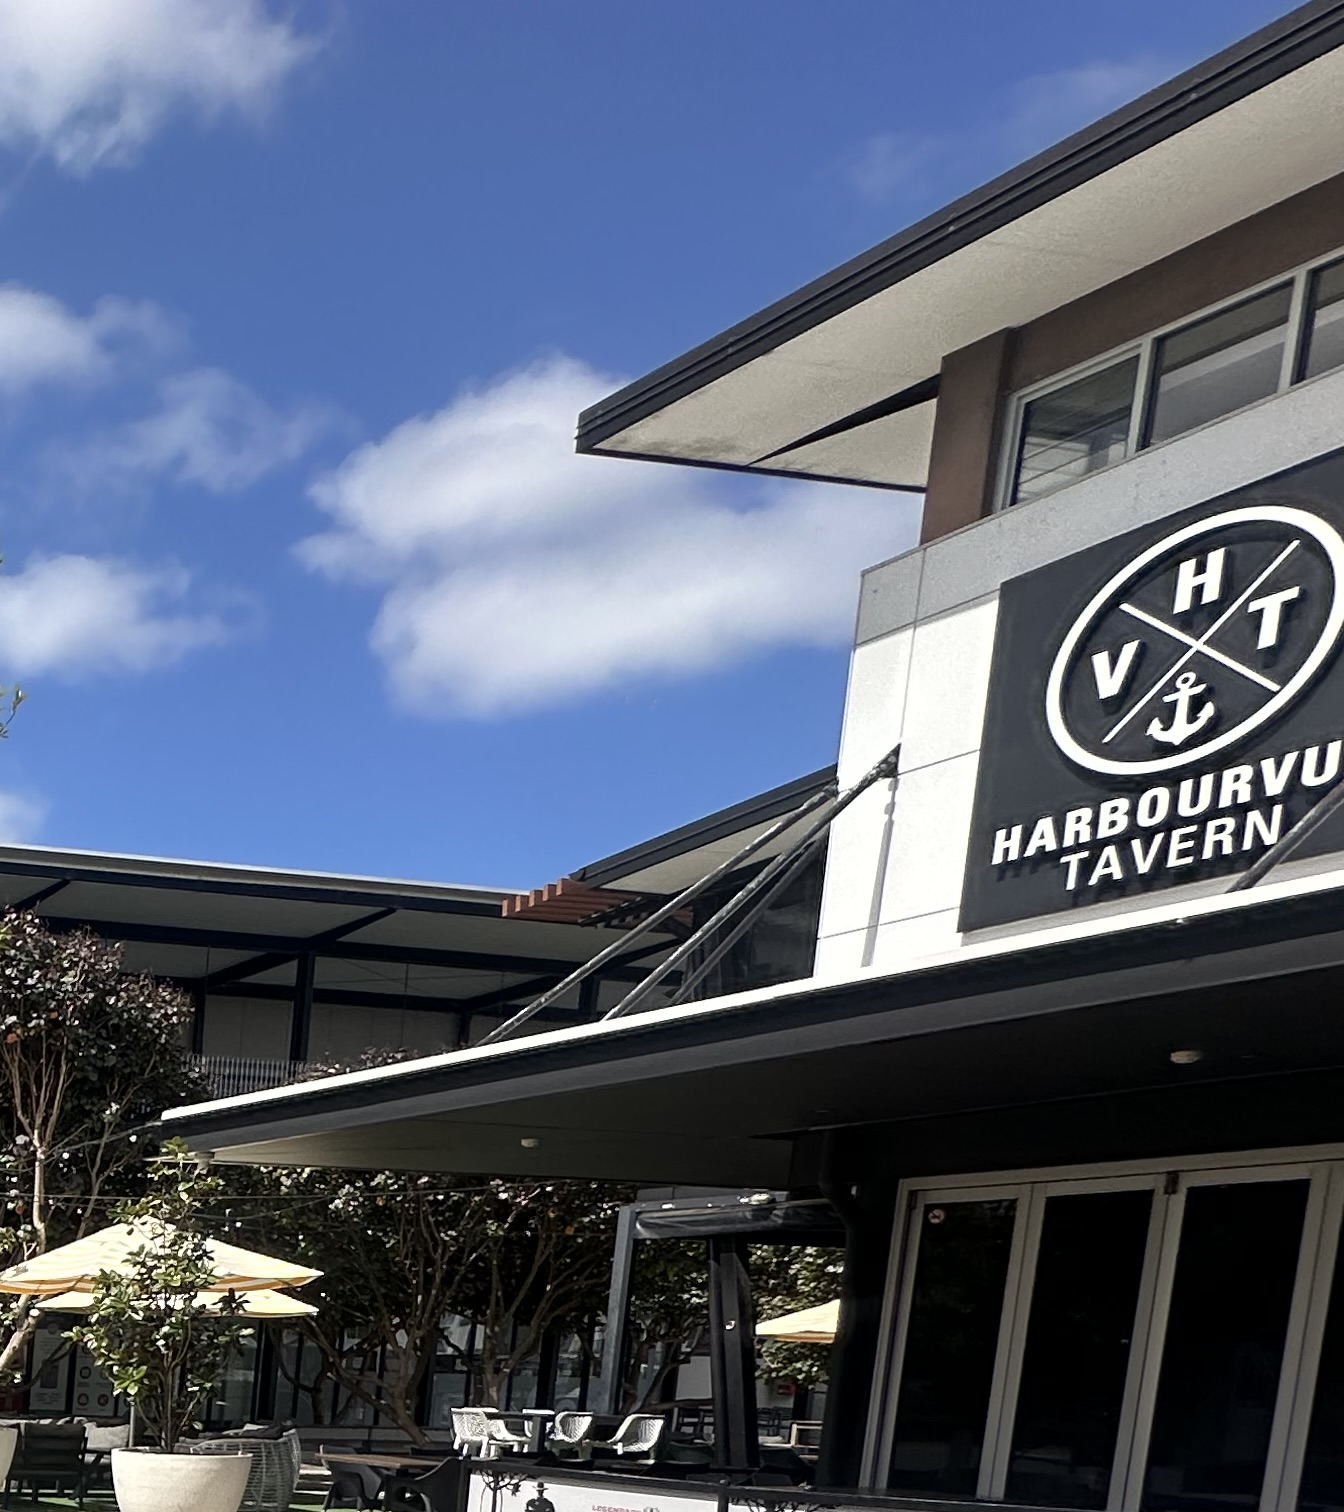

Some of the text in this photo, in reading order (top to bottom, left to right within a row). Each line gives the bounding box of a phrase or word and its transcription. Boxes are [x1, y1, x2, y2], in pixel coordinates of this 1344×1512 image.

[1173, 547, 1227, 615] H
[1247, 585, 1301, 650] T
[1091, 639, 1141, 700] V
[991, 739, 1343, 866] HARBOURVU
[1060, 804, 1284, 891] TAVERN
